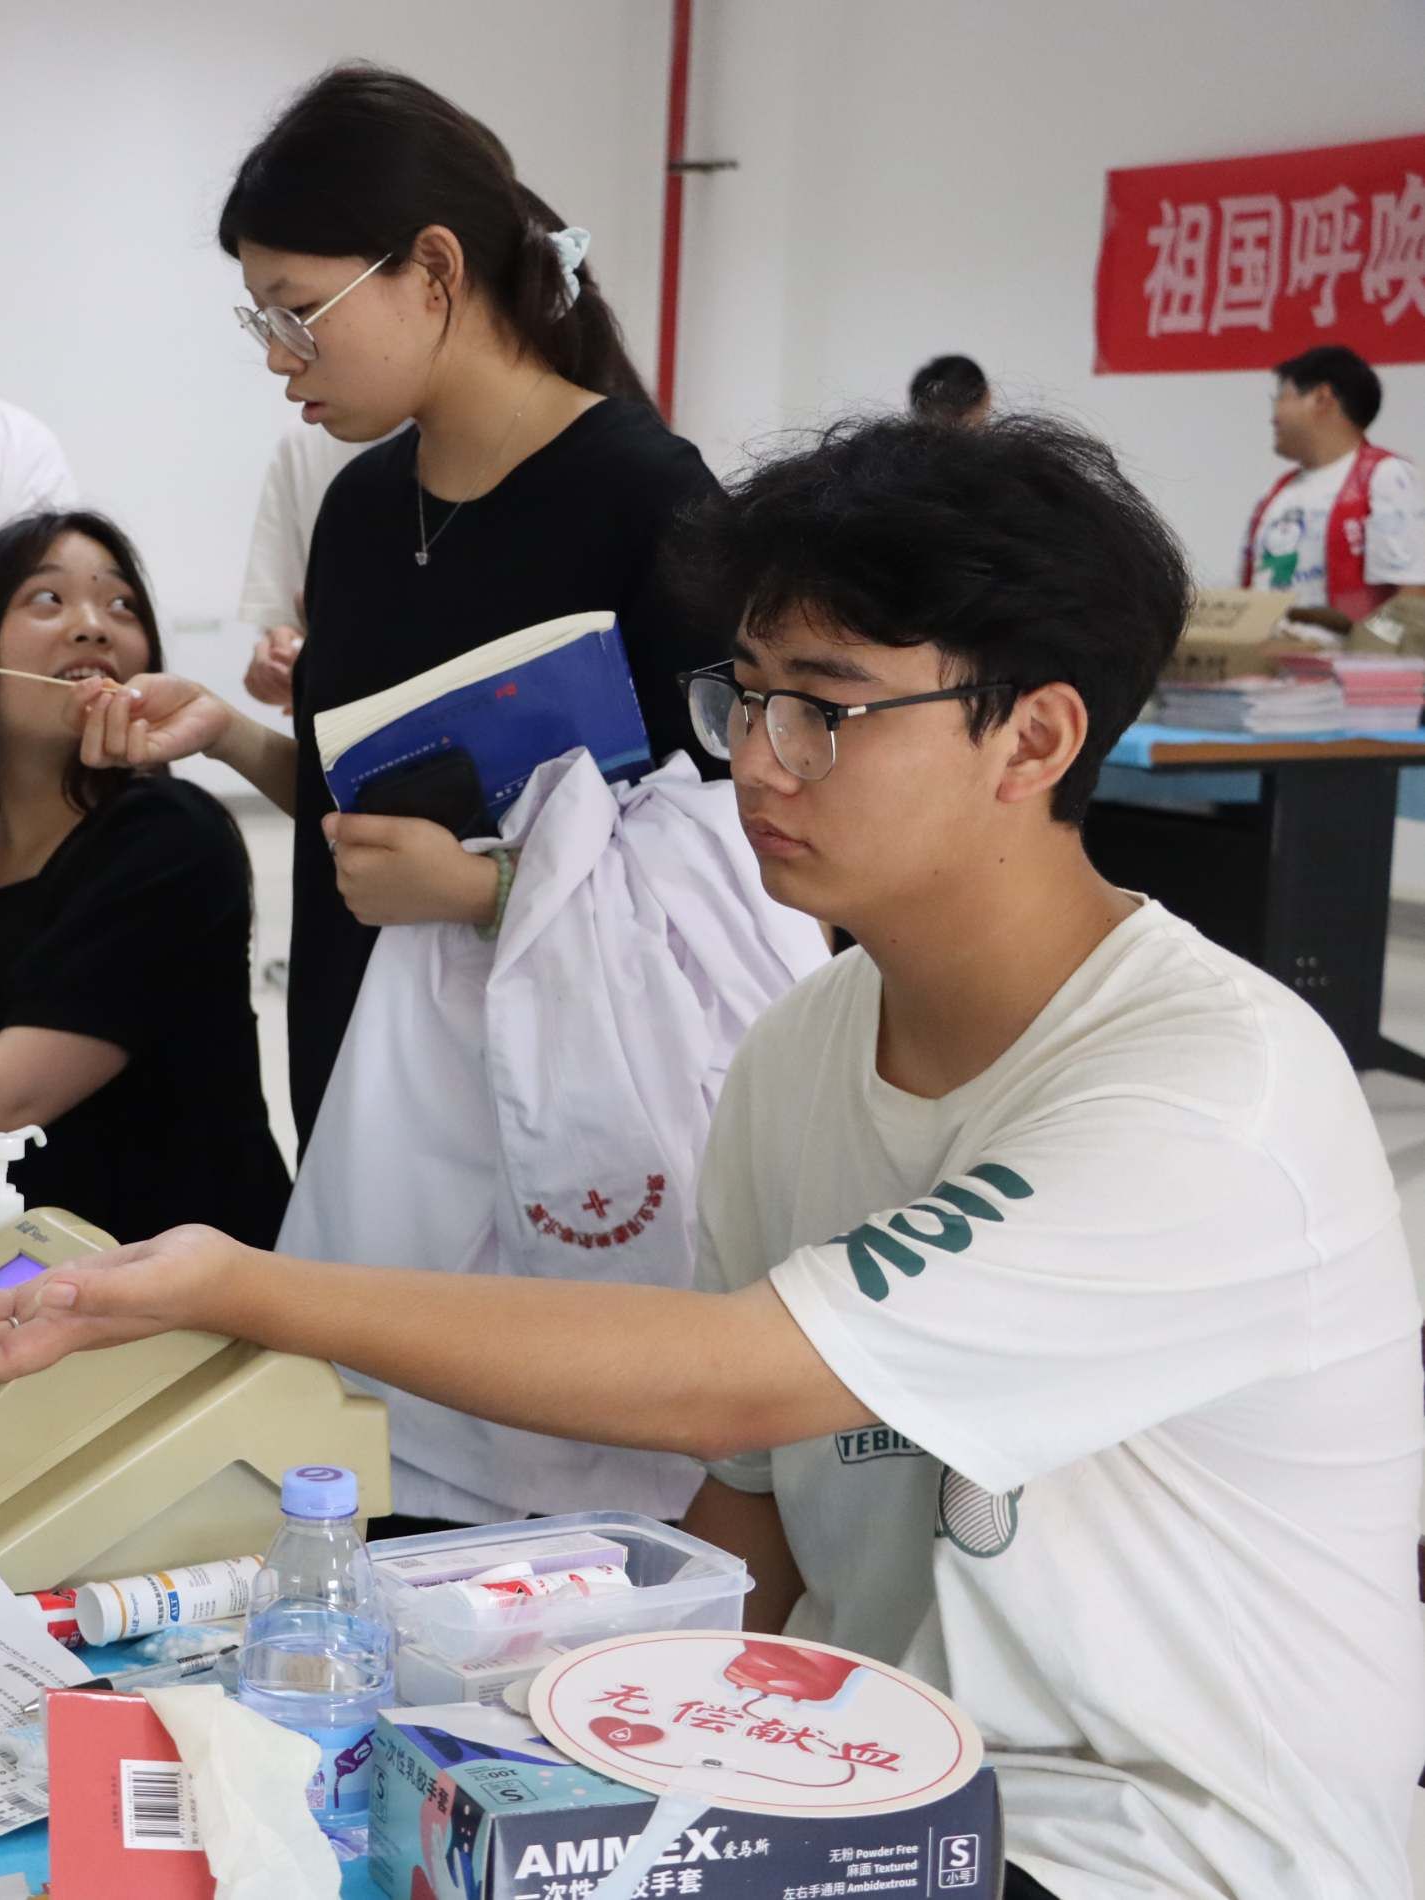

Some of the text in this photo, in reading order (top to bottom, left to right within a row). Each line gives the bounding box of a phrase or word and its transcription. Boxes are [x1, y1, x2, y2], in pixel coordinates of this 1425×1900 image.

[590, 1684, 900, 1772] 无偿献血
[722, 1838, 770, 1860] 爱马斯
[829, 1845, 919, 1863] 无粉 Powder Free
[949, 1838, 969, 1867] S
[846, 1860, 918, 1878] 麻面 Textured
[946, 1871, 972, 1885] 小号
[783, 1877, 918, 1900] 左右手通用 Ambidextrous
